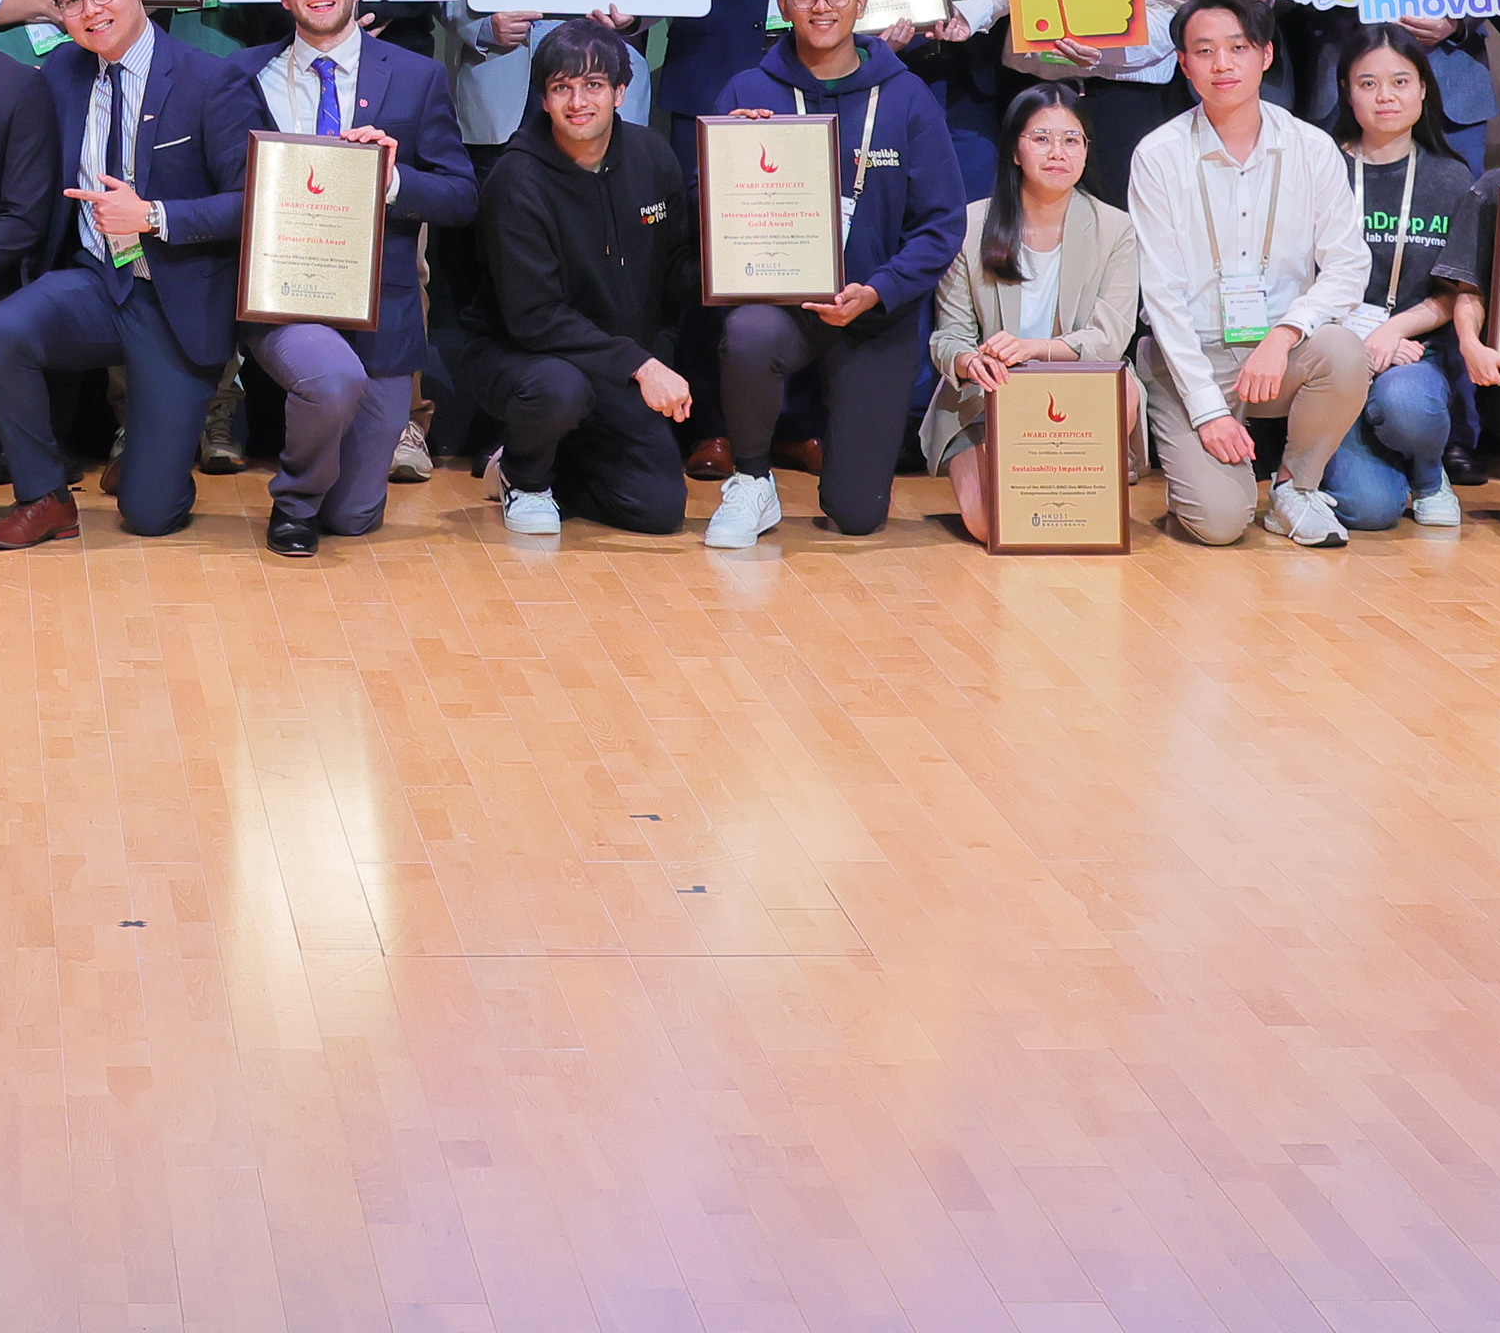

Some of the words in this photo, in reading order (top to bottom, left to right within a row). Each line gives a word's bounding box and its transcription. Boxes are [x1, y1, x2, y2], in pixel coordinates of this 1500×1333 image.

[748, 220, 767, 228] Gold
[325, 238, 346, 246] Award
[1012, 465, 1058, 473] Sustainability
[1058, 465, 1082, 473] Impact
